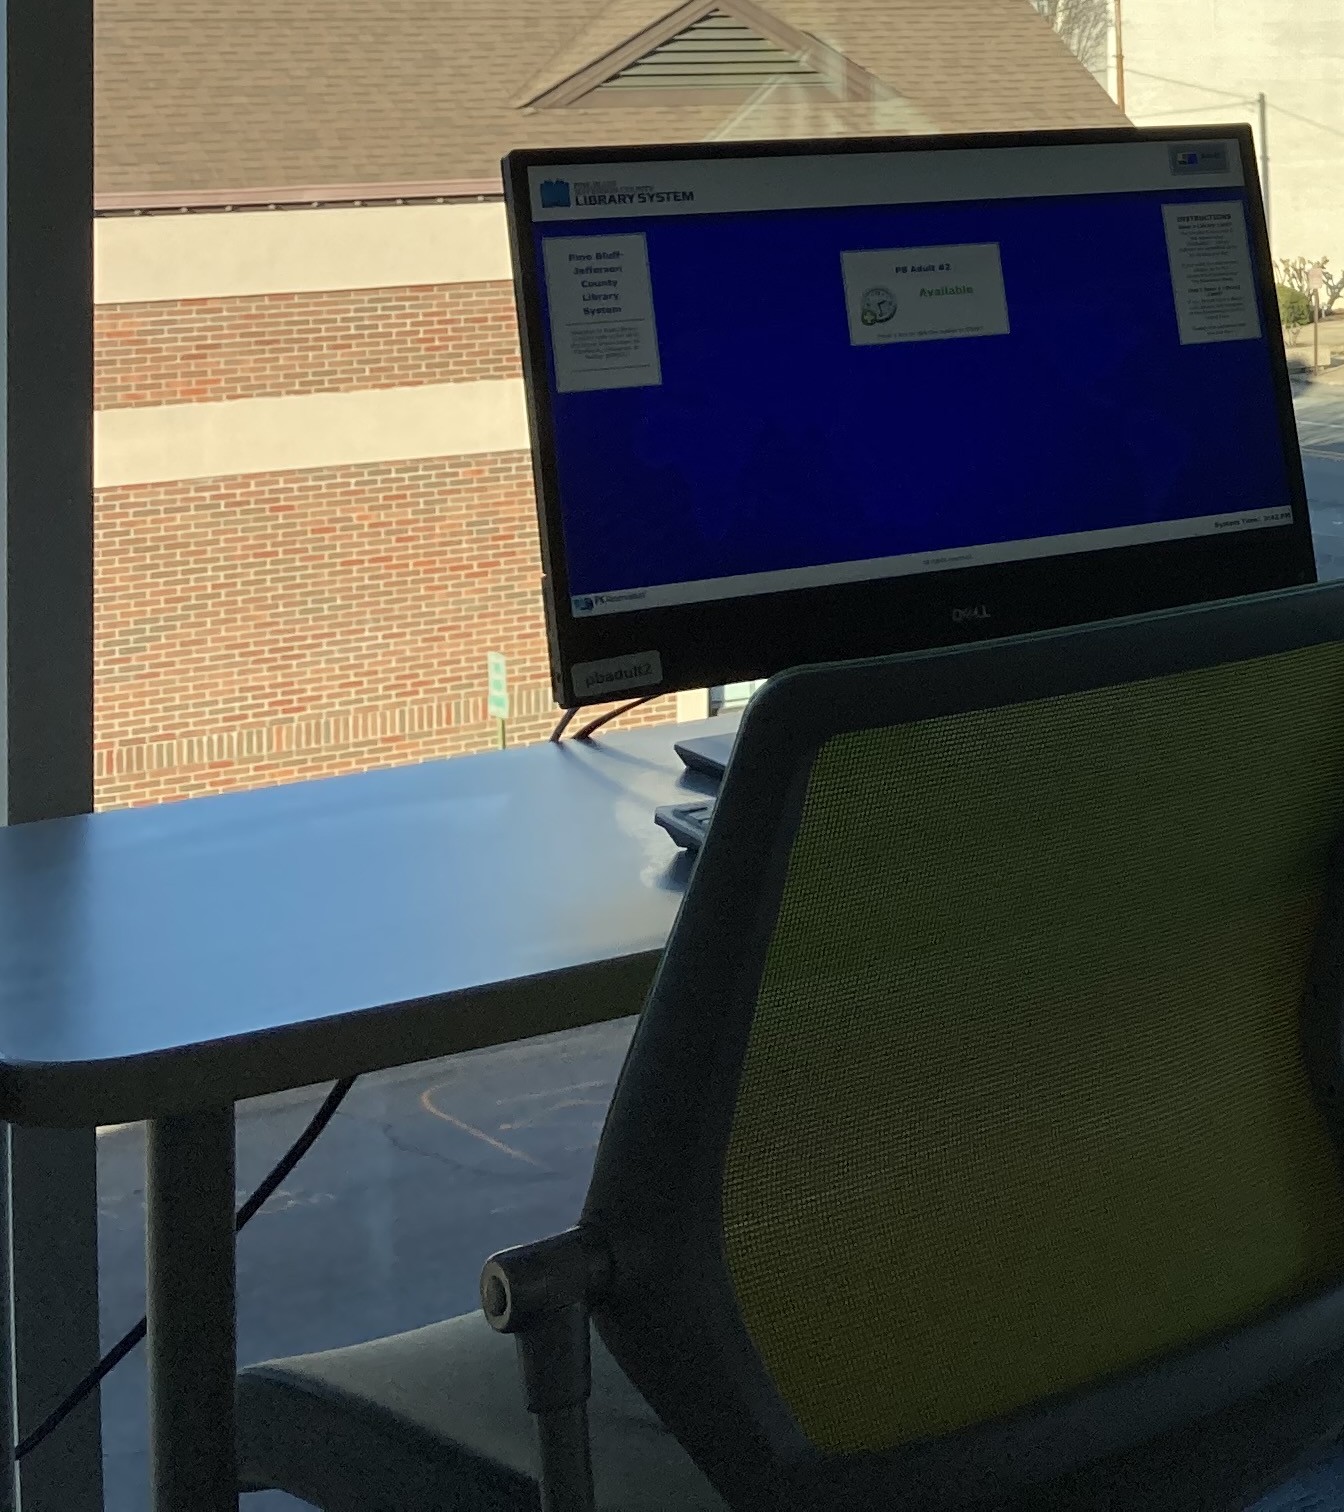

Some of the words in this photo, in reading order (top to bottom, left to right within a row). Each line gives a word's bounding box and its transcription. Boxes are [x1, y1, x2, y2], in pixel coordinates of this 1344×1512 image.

[575, 193, 636, 206] LIBRARY
[638, 191, 695, 204] SYSTEM
[910, 263, 936, 273] Adult
[580, 279, 618, 289] County
[919, 285, 974, 298] Available
[582, 292, 620, 303] Library
[583, 306, 622, 317] System
[585, 662, 654, 689] pbadult2
